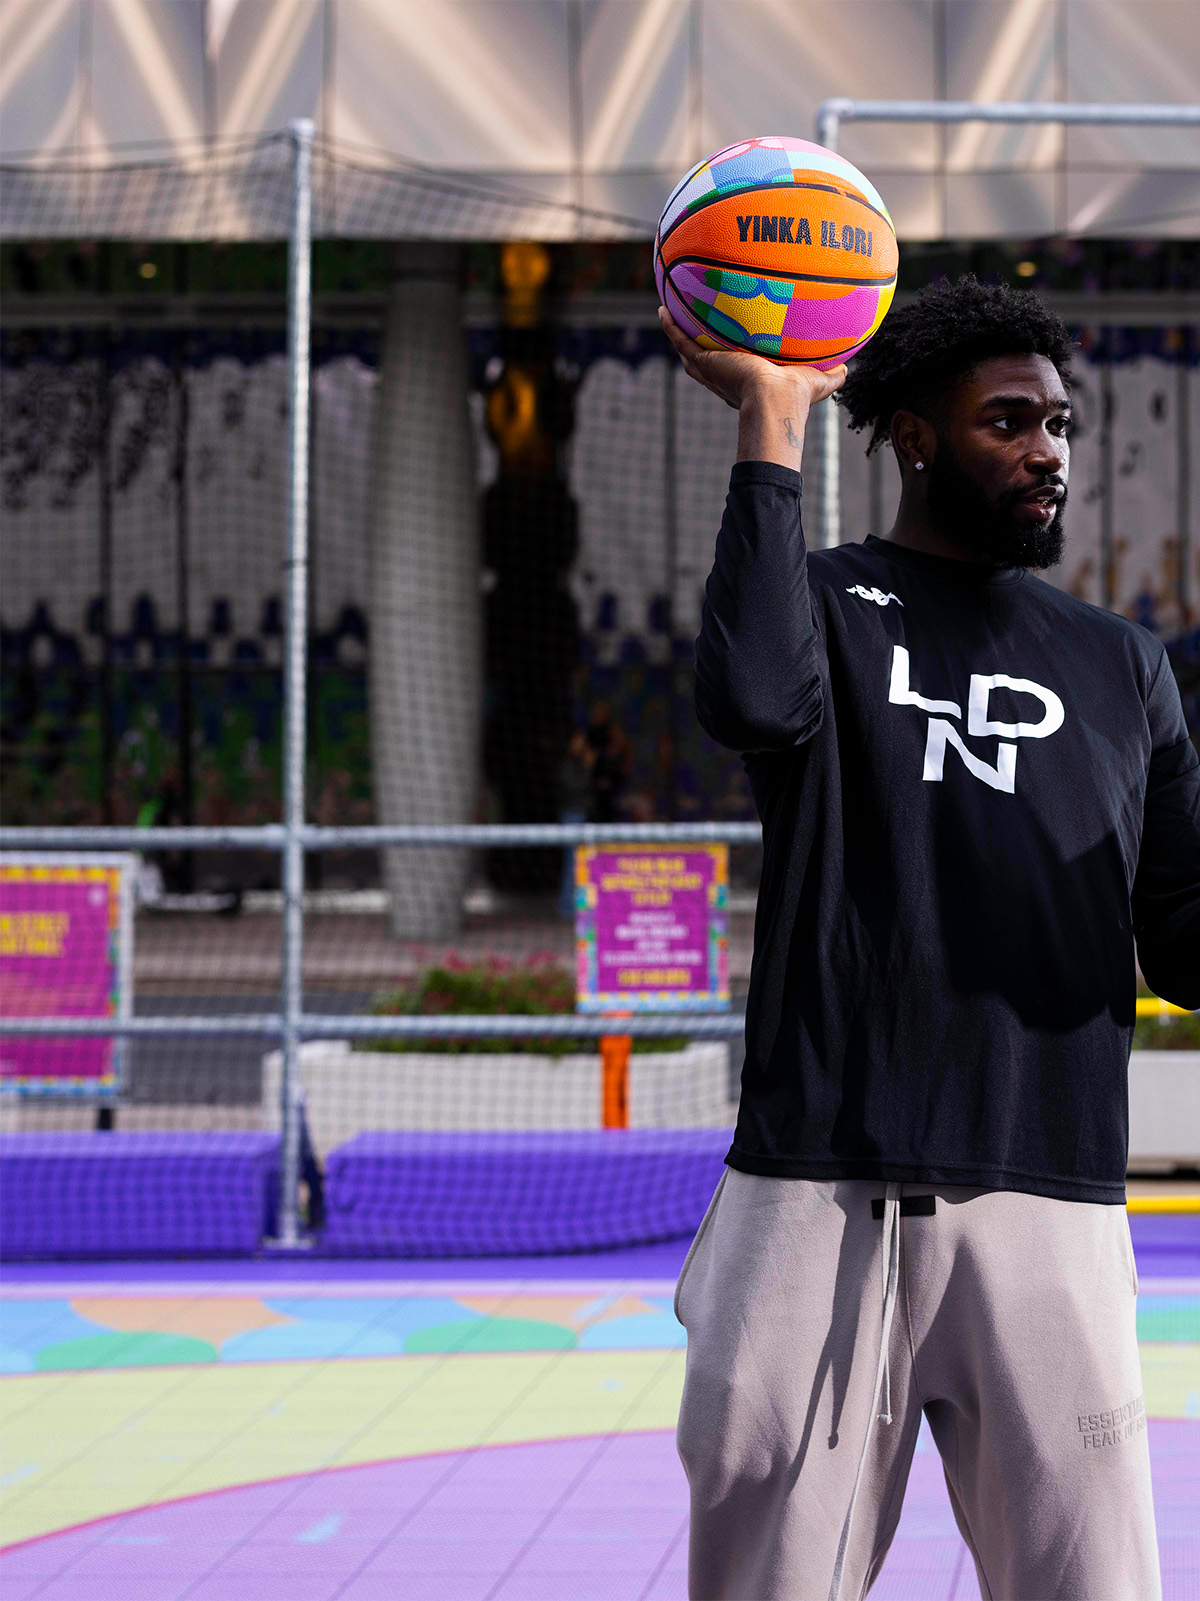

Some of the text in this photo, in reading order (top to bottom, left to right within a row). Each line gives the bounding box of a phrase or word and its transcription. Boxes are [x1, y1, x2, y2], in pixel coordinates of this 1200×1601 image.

[736, 215, 873, 258] YINKA ILORI
[1083, 1430, 1121, 1450] FEAR
